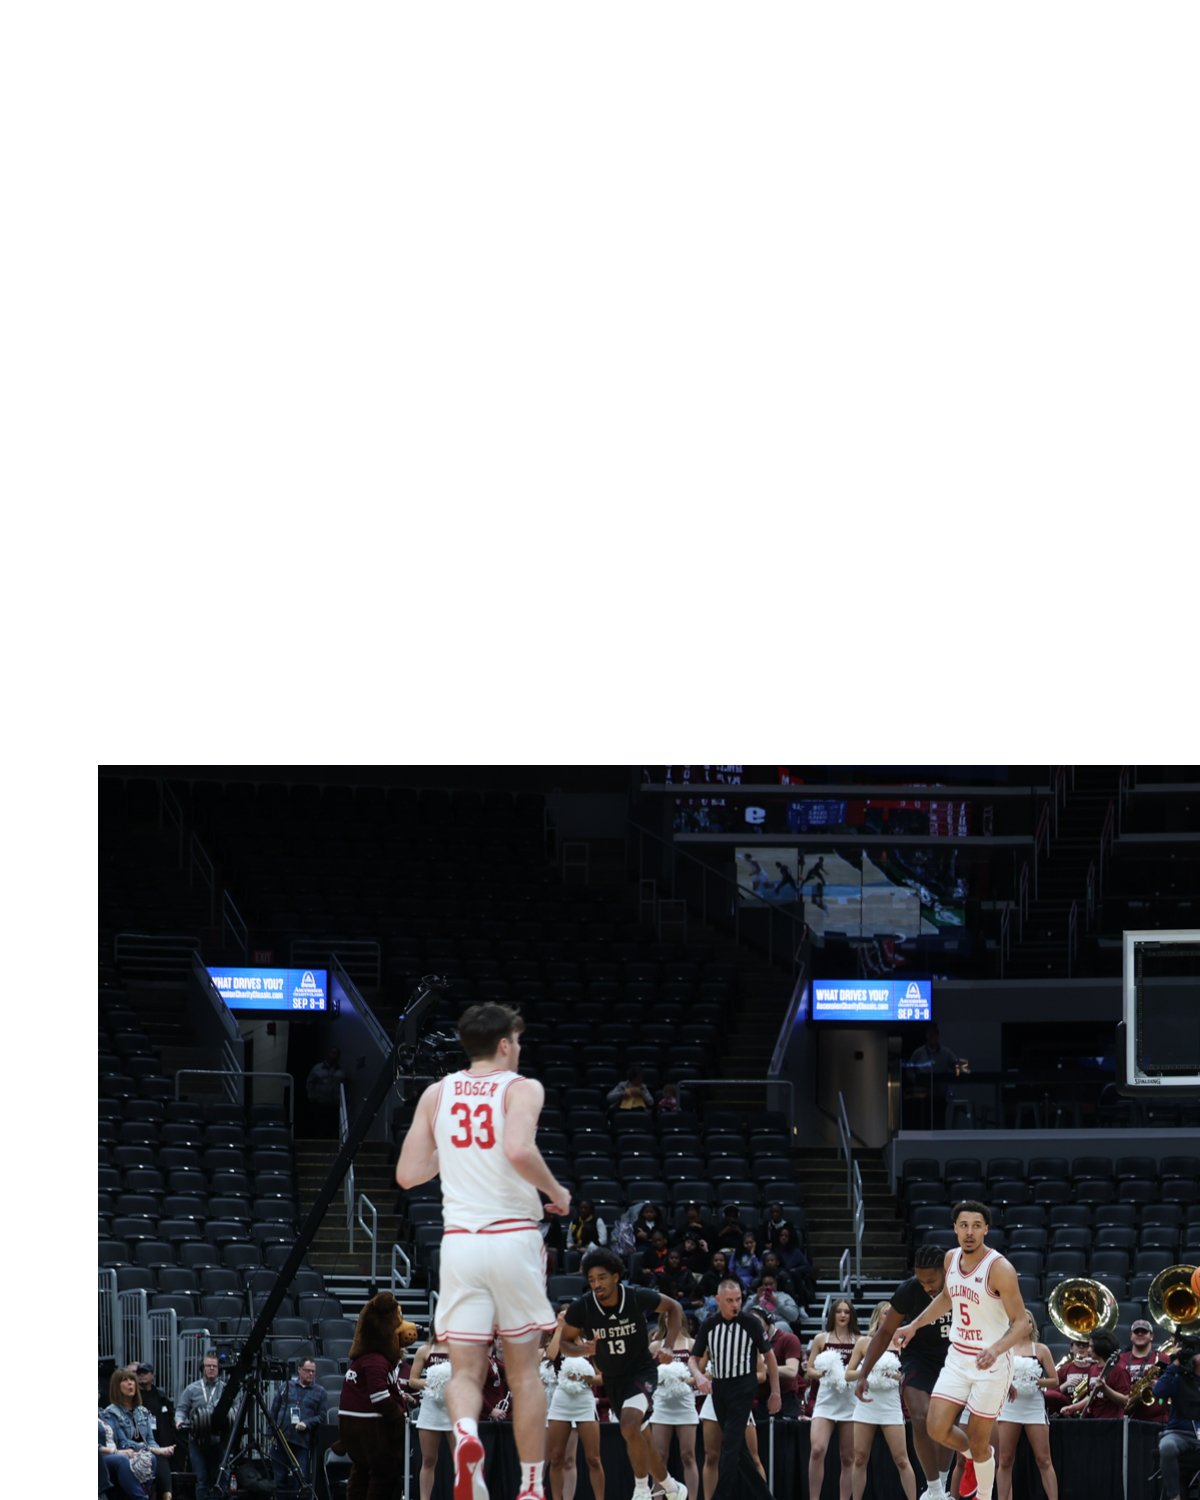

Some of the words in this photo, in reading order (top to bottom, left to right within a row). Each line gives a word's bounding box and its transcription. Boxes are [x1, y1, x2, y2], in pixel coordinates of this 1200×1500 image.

[211, 977, 232, 989] WHAT
[234, 977, 261, 990] DRIVES
[263, 978, 284, 990] YOU?
[816, 989, 838, 1001] WHAT
[840, 989, 867, 1001] DRIVES
[869, 989, 889, 1002] YOU?
[292, 998, 308, 1009] SEP
[898, 1009, 913, 1019] SEP
[454, 1081, 498, 1097] BOSER
[450, 1102, 496, 1149] 33
[949, 1284, 980, 1305] ILLINOIS
[959, 1303, 971, 1326] 5
[592, 1328, 607, 1339] MO
[608, 1323, 637, 1338] STATE
[940, 1325, 951, 1338] 9
[957, 1327, 983, 1341] STATE
[608, 1340, 626, 1355] 13
